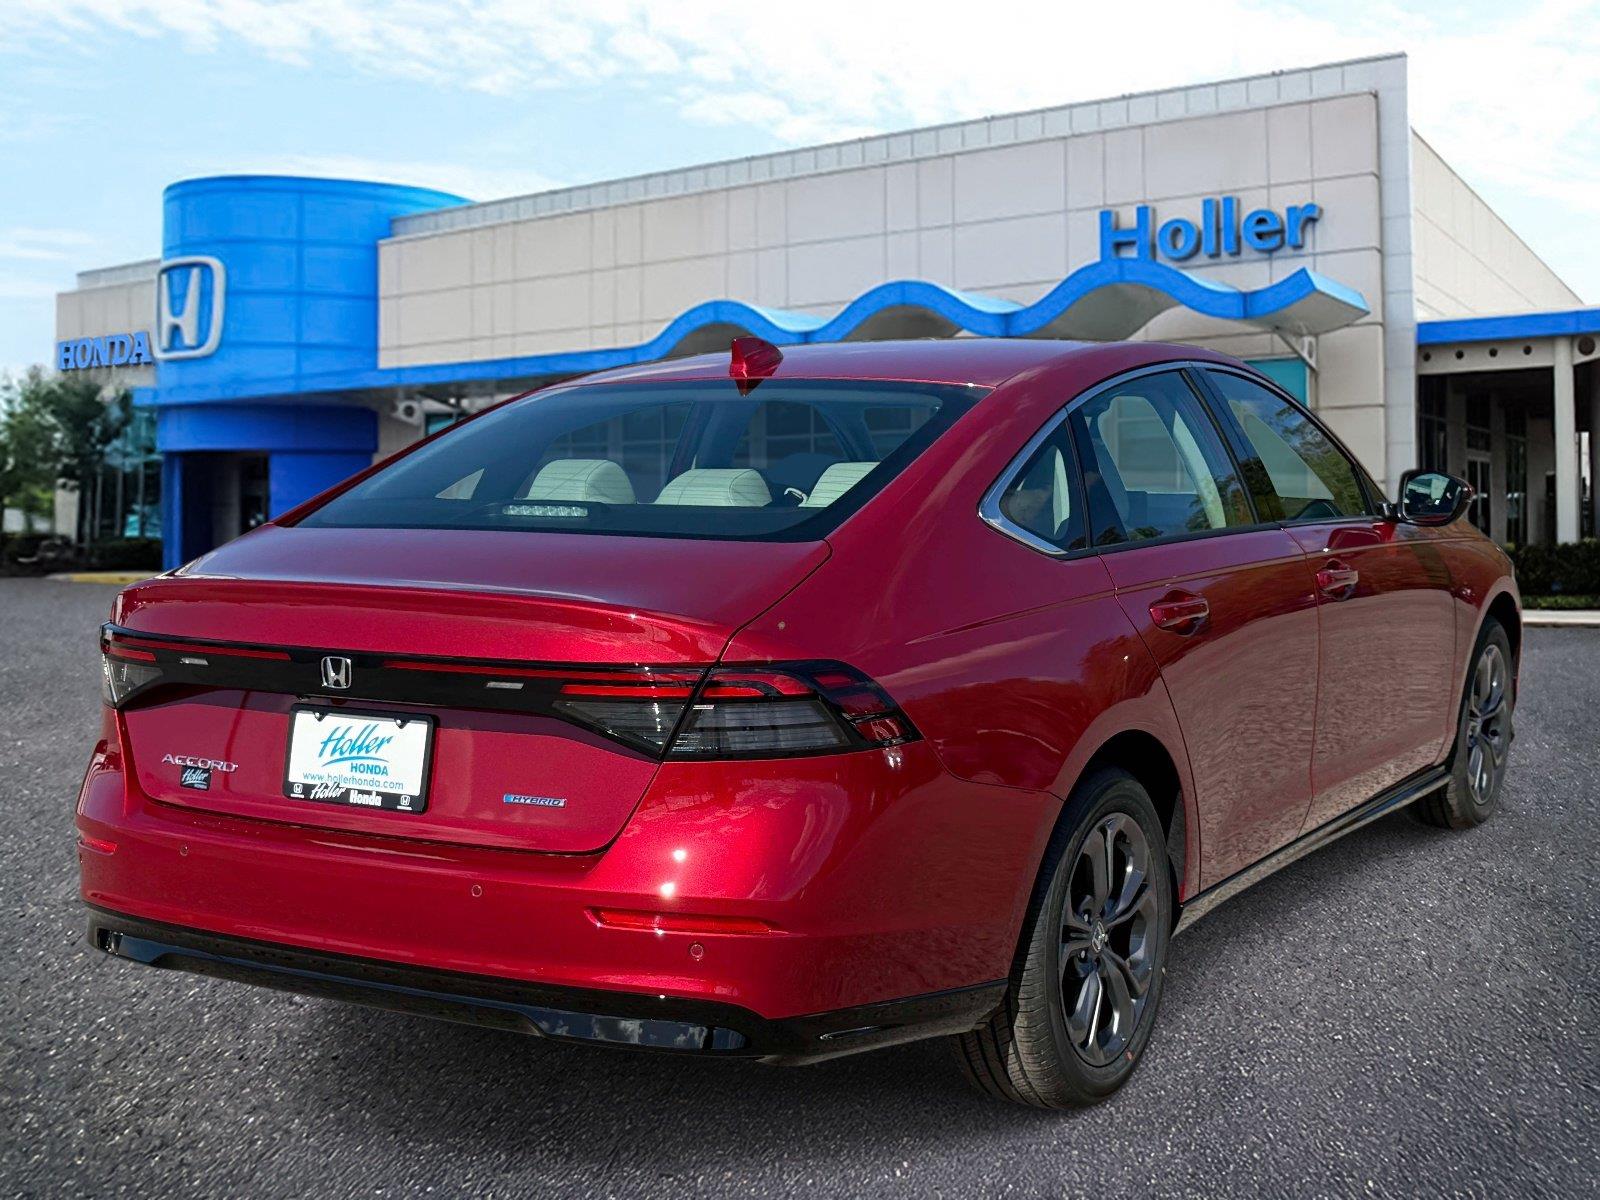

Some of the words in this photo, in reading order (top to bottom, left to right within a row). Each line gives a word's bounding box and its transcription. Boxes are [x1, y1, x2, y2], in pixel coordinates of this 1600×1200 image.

[1099, 196, 1322, 262] Holler
[58, 331, 153, 371] HONDA
[318, 723, 394, 758] Holler
[161, 753, 239, 772] ACCORD
[350, 762, 389, 777] HONDA
[302, 771, 404, 790] www.hollerhonda.com
[309, 782, 347, 800] Holler
[349, 789, 383, 807] Honda
[512, 796, 562, 806] HYBRID
